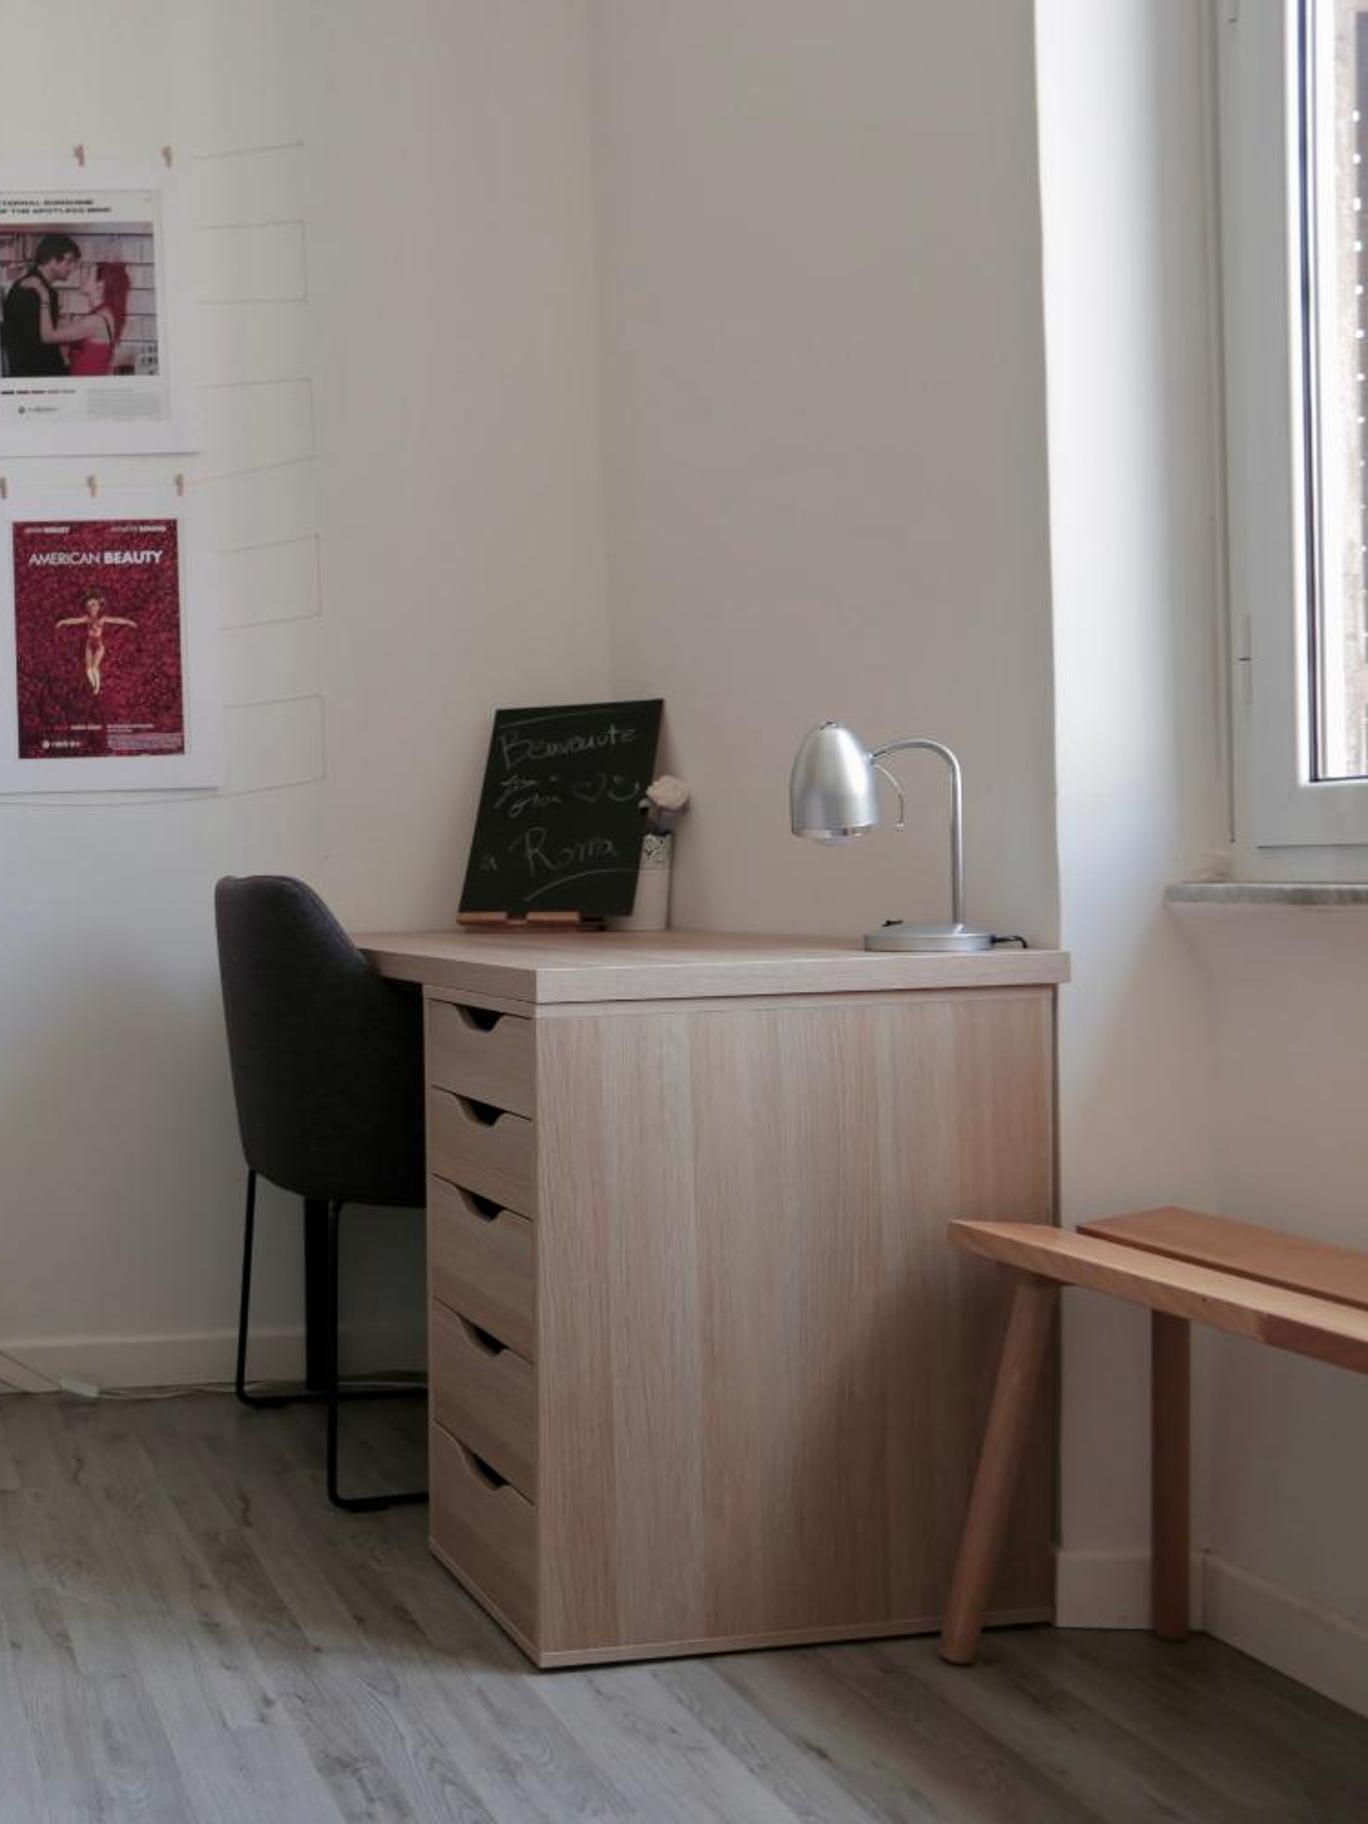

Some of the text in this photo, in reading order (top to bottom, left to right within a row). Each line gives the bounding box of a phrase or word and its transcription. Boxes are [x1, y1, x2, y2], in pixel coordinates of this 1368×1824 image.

[28, 549, 164, 566] AMERICAN BEAUTY
[509, 826, 618, 877] Roma
